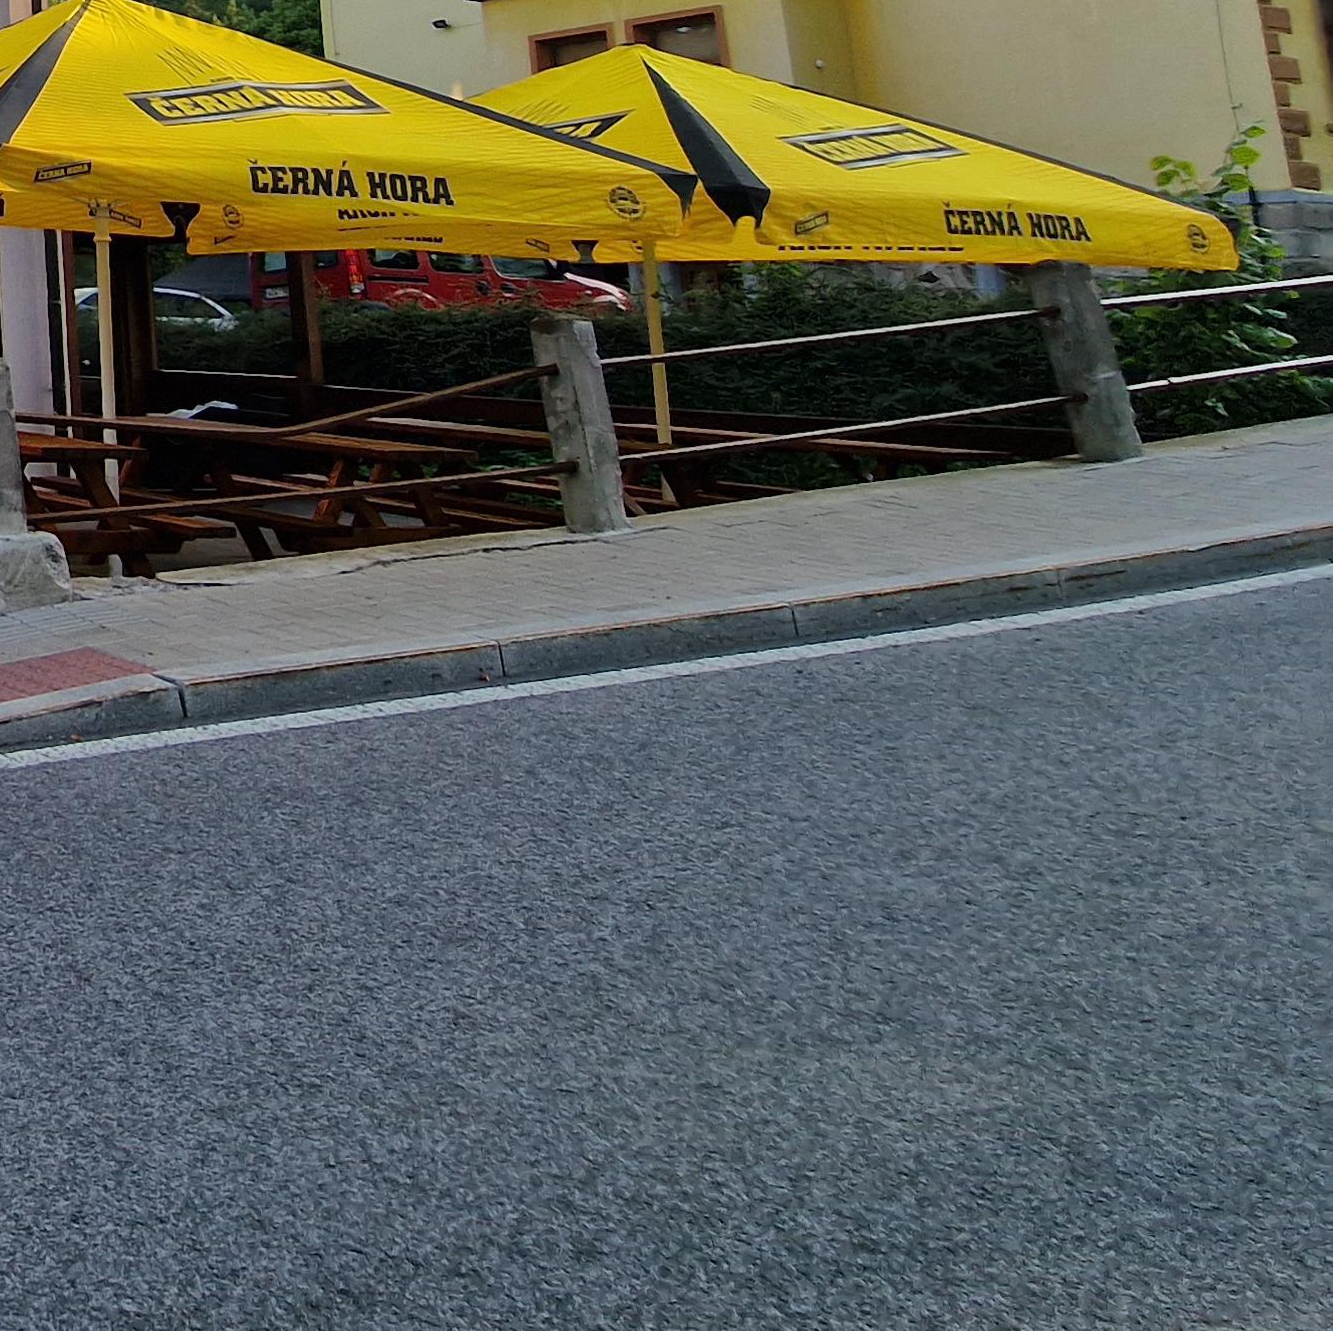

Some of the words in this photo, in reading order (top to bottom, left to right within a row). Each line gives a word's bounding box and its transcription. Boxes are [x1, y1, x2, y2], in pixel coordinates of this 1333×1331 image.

[149, 85, 278, 118] ČERNÁ
[265, 89, 367, 108] HORA
[247, 158, 360, 199] ČERNÁ
[365, 170, 455, 207] HORA
[941, 201, 1024, 237] ČERNÁ
[1026, 212, 1093, 243] HORA
